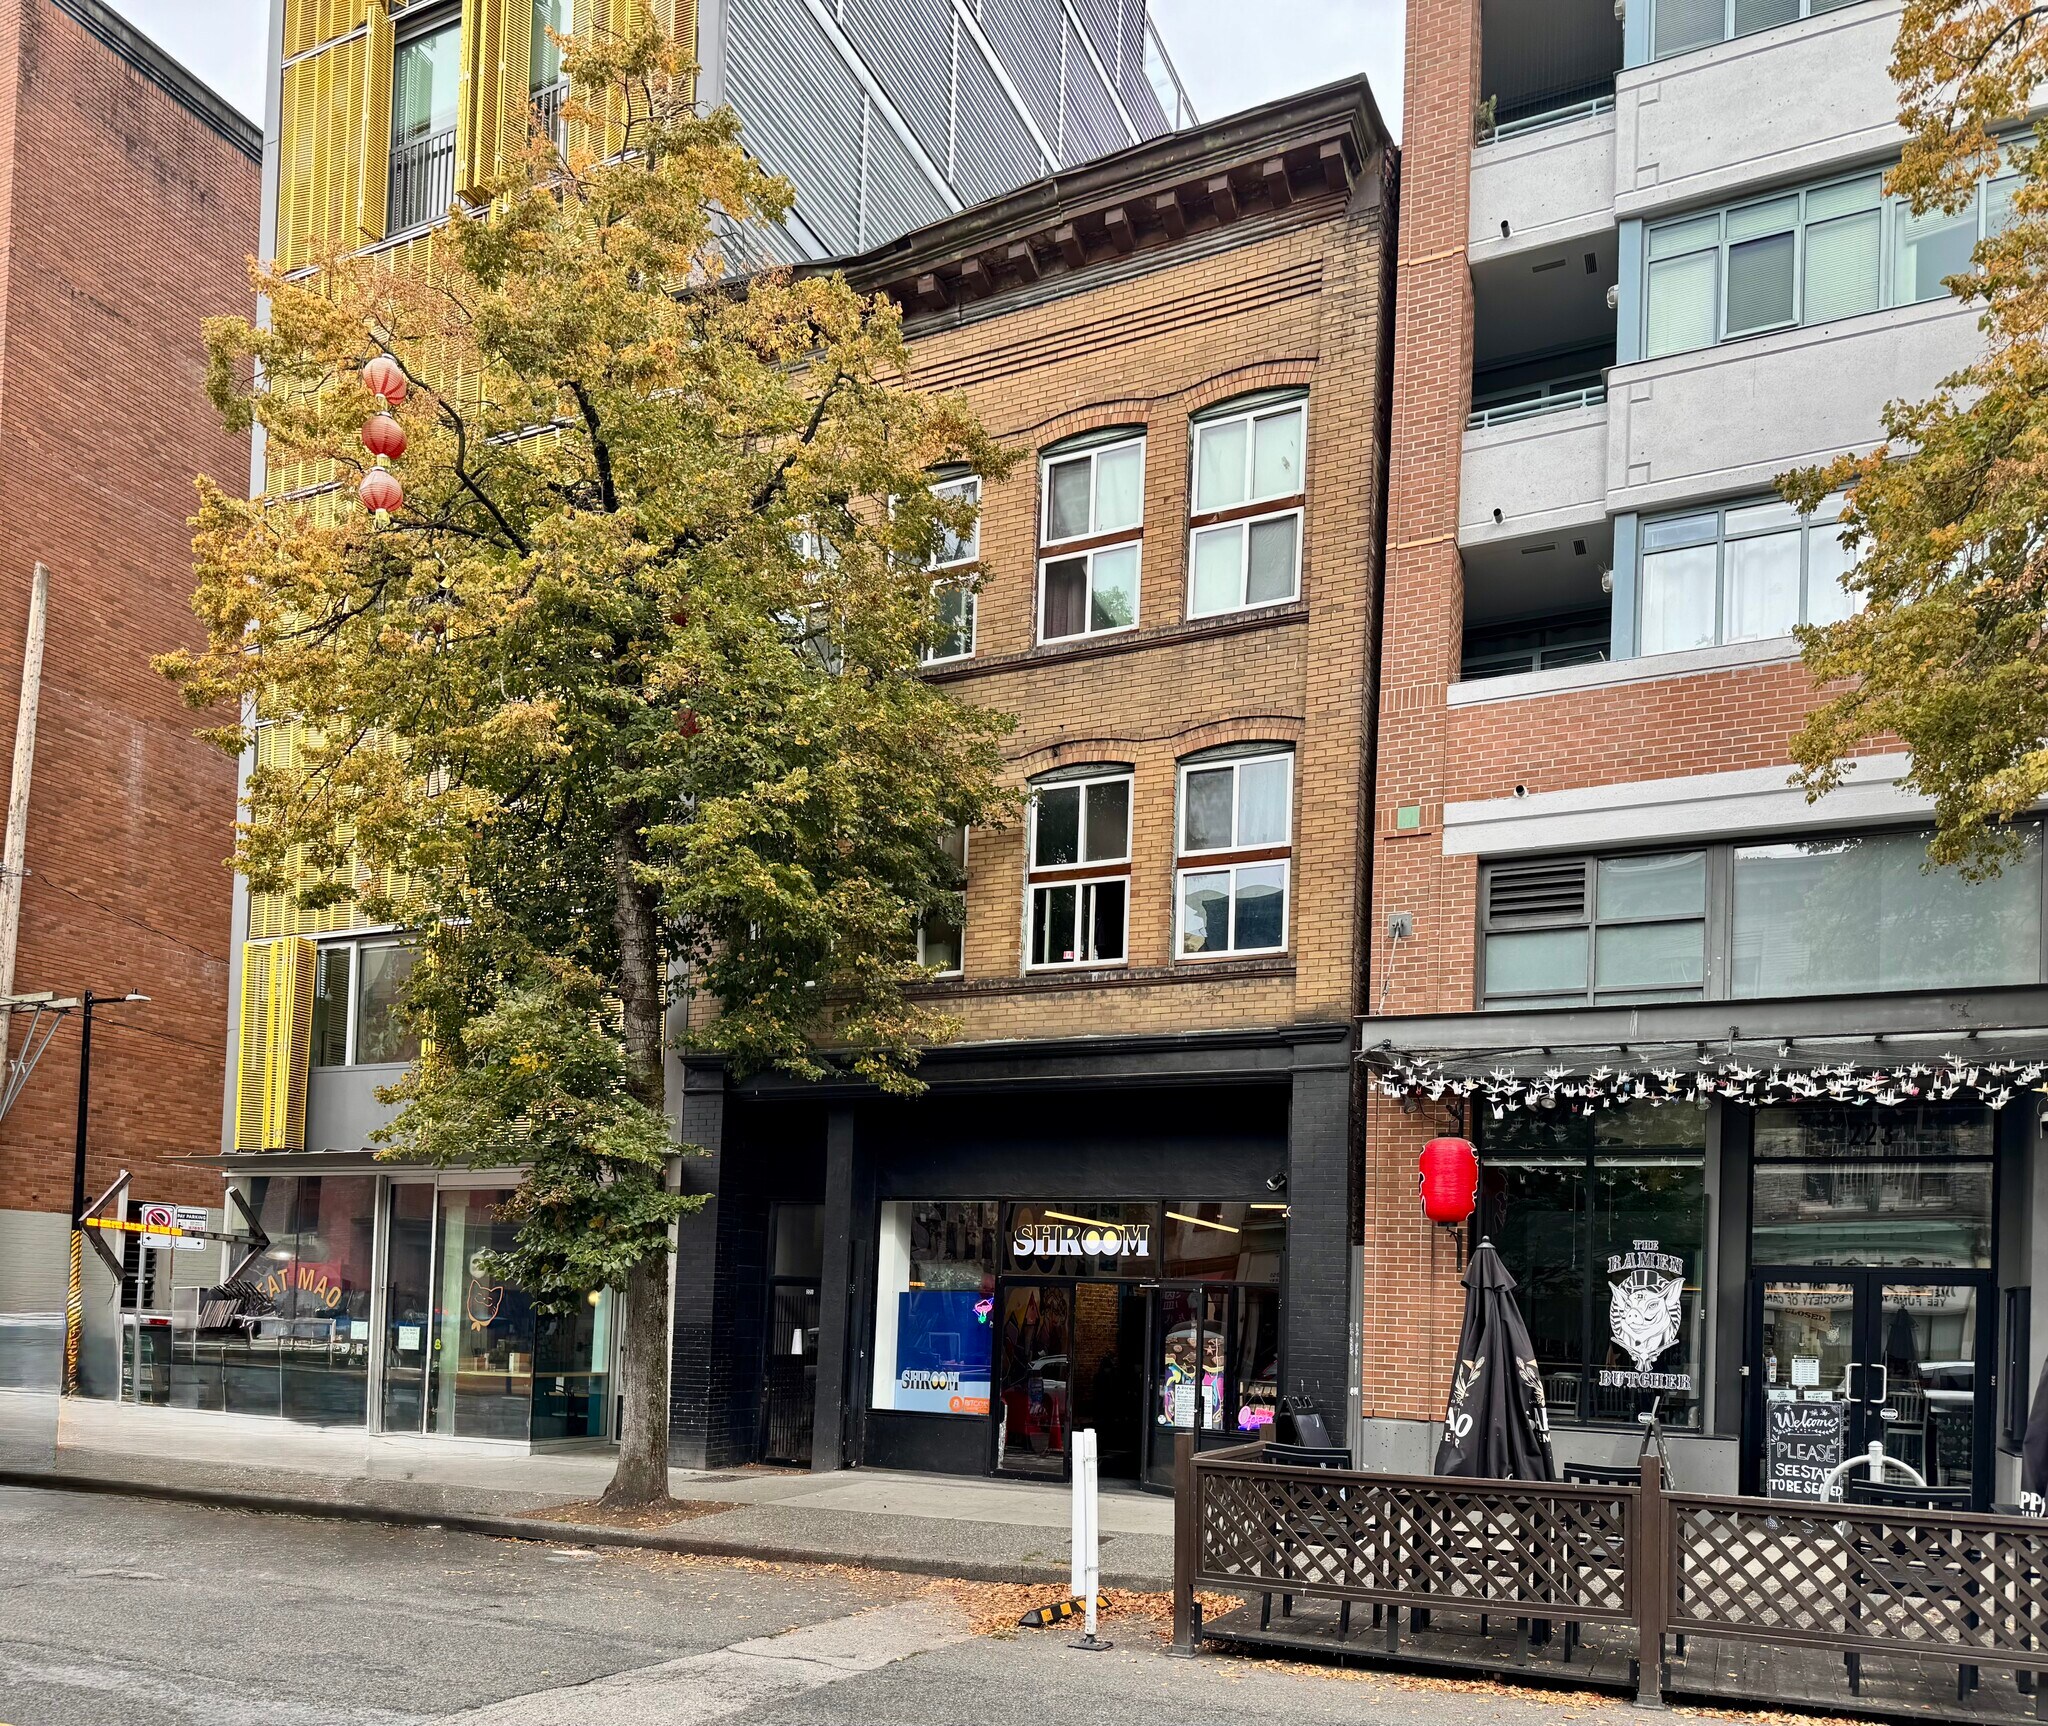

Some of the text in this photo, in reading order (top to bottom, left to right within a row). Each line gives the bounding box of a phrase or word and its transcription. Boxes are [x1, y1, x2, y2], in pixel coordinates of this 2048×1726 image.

[1013, 1223, 1150, 1257] SHROOM
[1633, 1240, 1659, 1251] THE
[1607, 1251, 1684, 1275] RAMEN
[298, 1267, 342, 1308] MAO
[1784, 1307, 1826, 1321] CLOSED
[901, 1369, 960, 1391] SHROOM
[1599, 1370, 1692, 1390] BUTCHER
[1238, 1405, 1273, 1431] Open
[1774, 1410, 1839, 1428] Welcome
[1777, 1441, 1836, 1463] PLEASE
[1775, 1463, 1800, 1477] SEE
